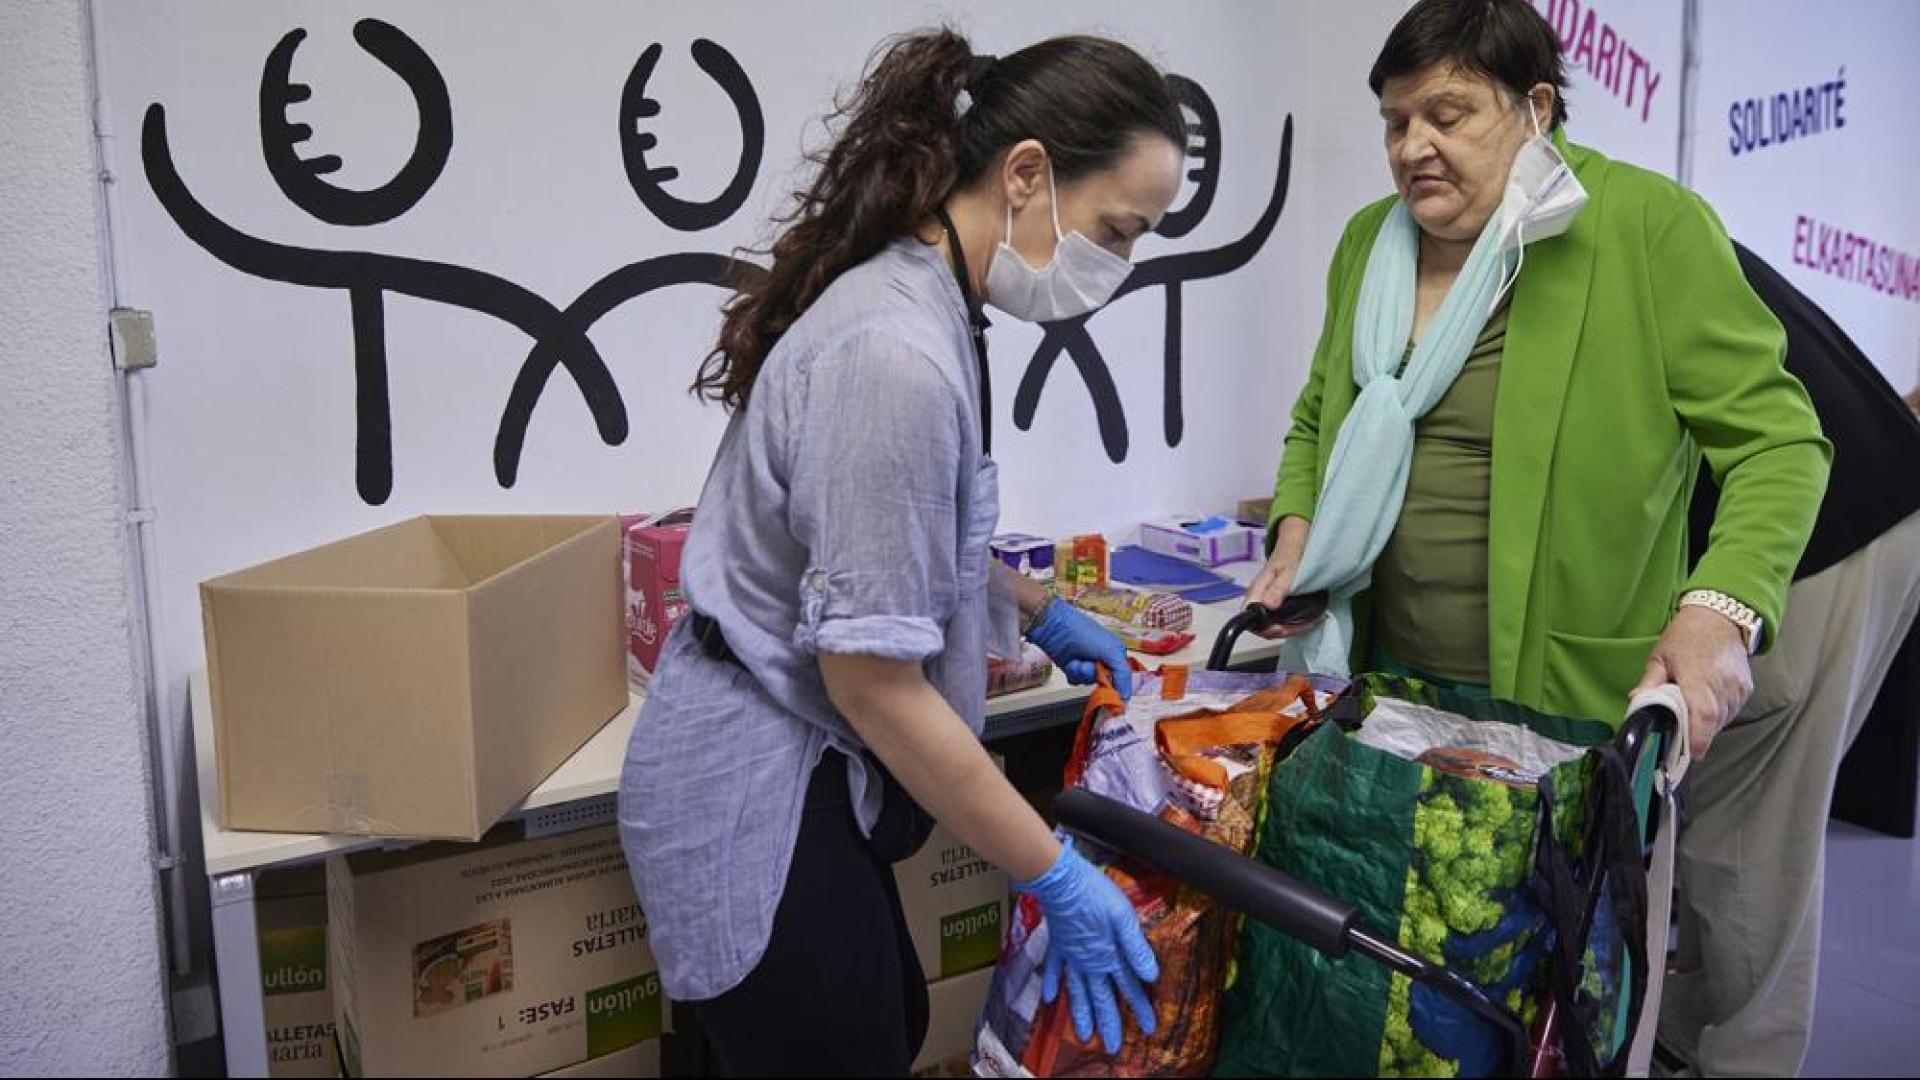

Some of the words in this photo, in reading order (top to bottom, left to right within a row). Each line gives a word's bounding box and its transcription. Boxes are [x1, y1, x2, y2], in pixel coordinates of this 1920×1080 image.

[1545, 0, 1660, 122] IDARITY
[1729, 65, 1847, 156] SOLIDARITÉ
[930, 860, 999, 887] ALLETAS
[943, 904, 999, 940] gullón
[573, 924, 647, 957] ALLETAS
[265, 964, 322, 987] ullón
[519, 997, 575, 1024] FASE:
[590, 976, 658, 1017] gullón
[498, 1016, 506, 1030] 1
